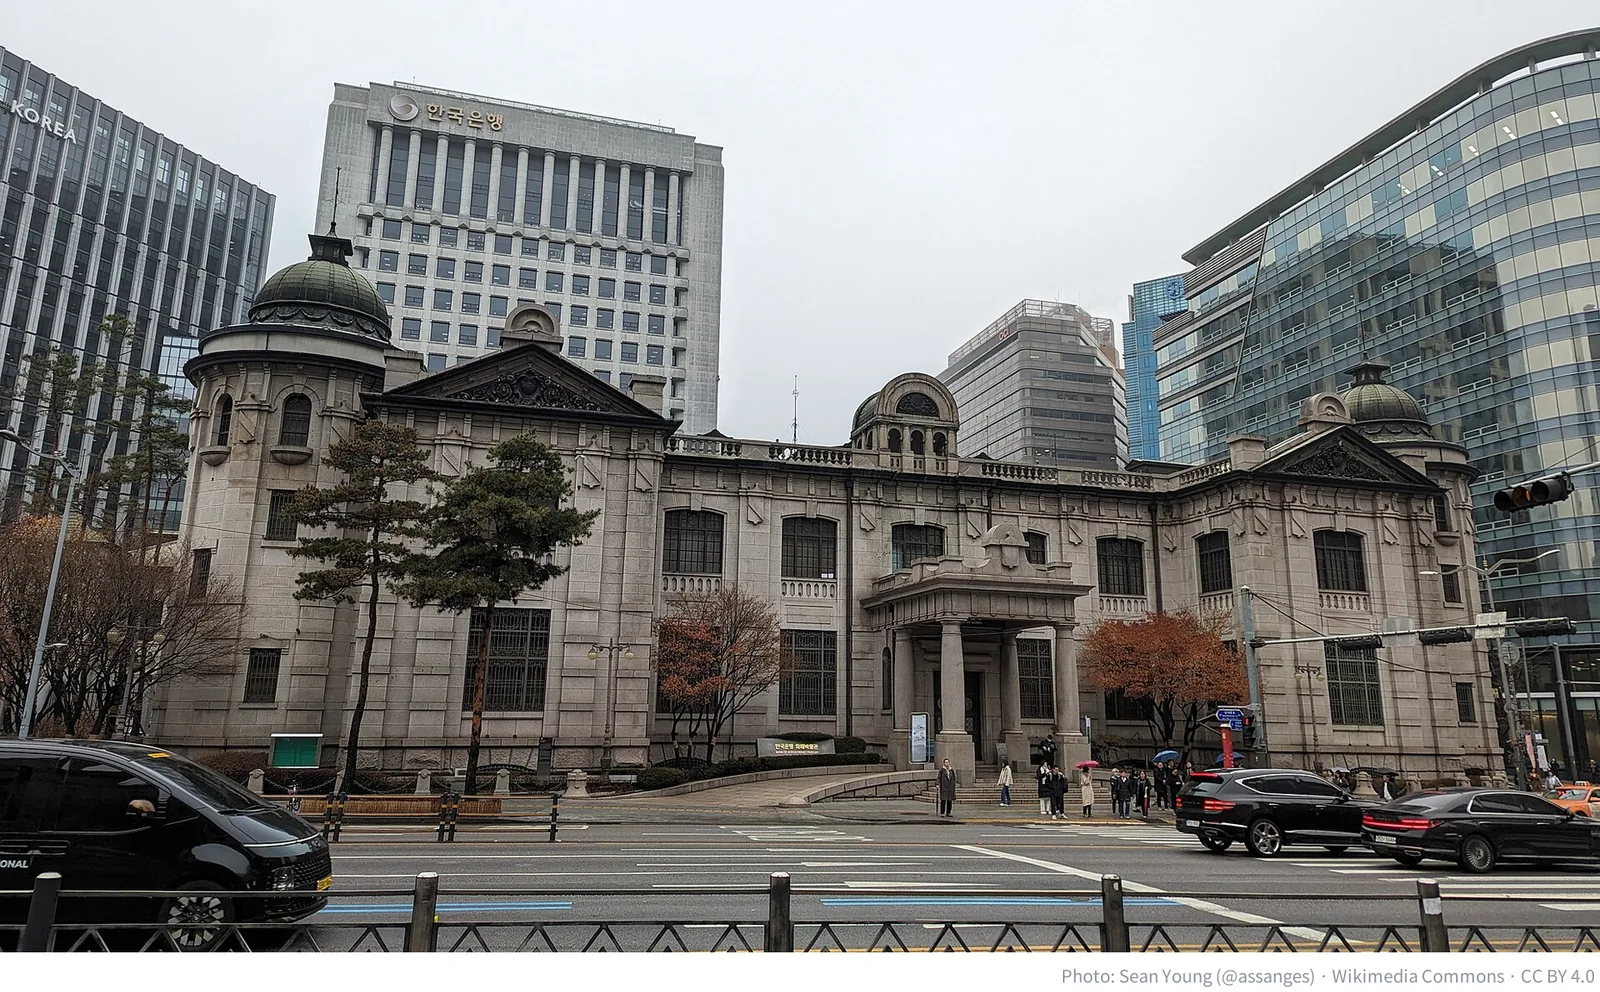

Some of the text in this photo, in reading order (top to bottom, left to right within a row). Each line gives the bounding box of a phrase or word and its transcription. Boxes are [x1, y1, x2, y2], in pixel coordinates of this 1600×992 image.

[10, 99, 77, 144] KOREA
[426, 103, 503, 131] 한국은행
[0, 859, 29, 869] ONAL
